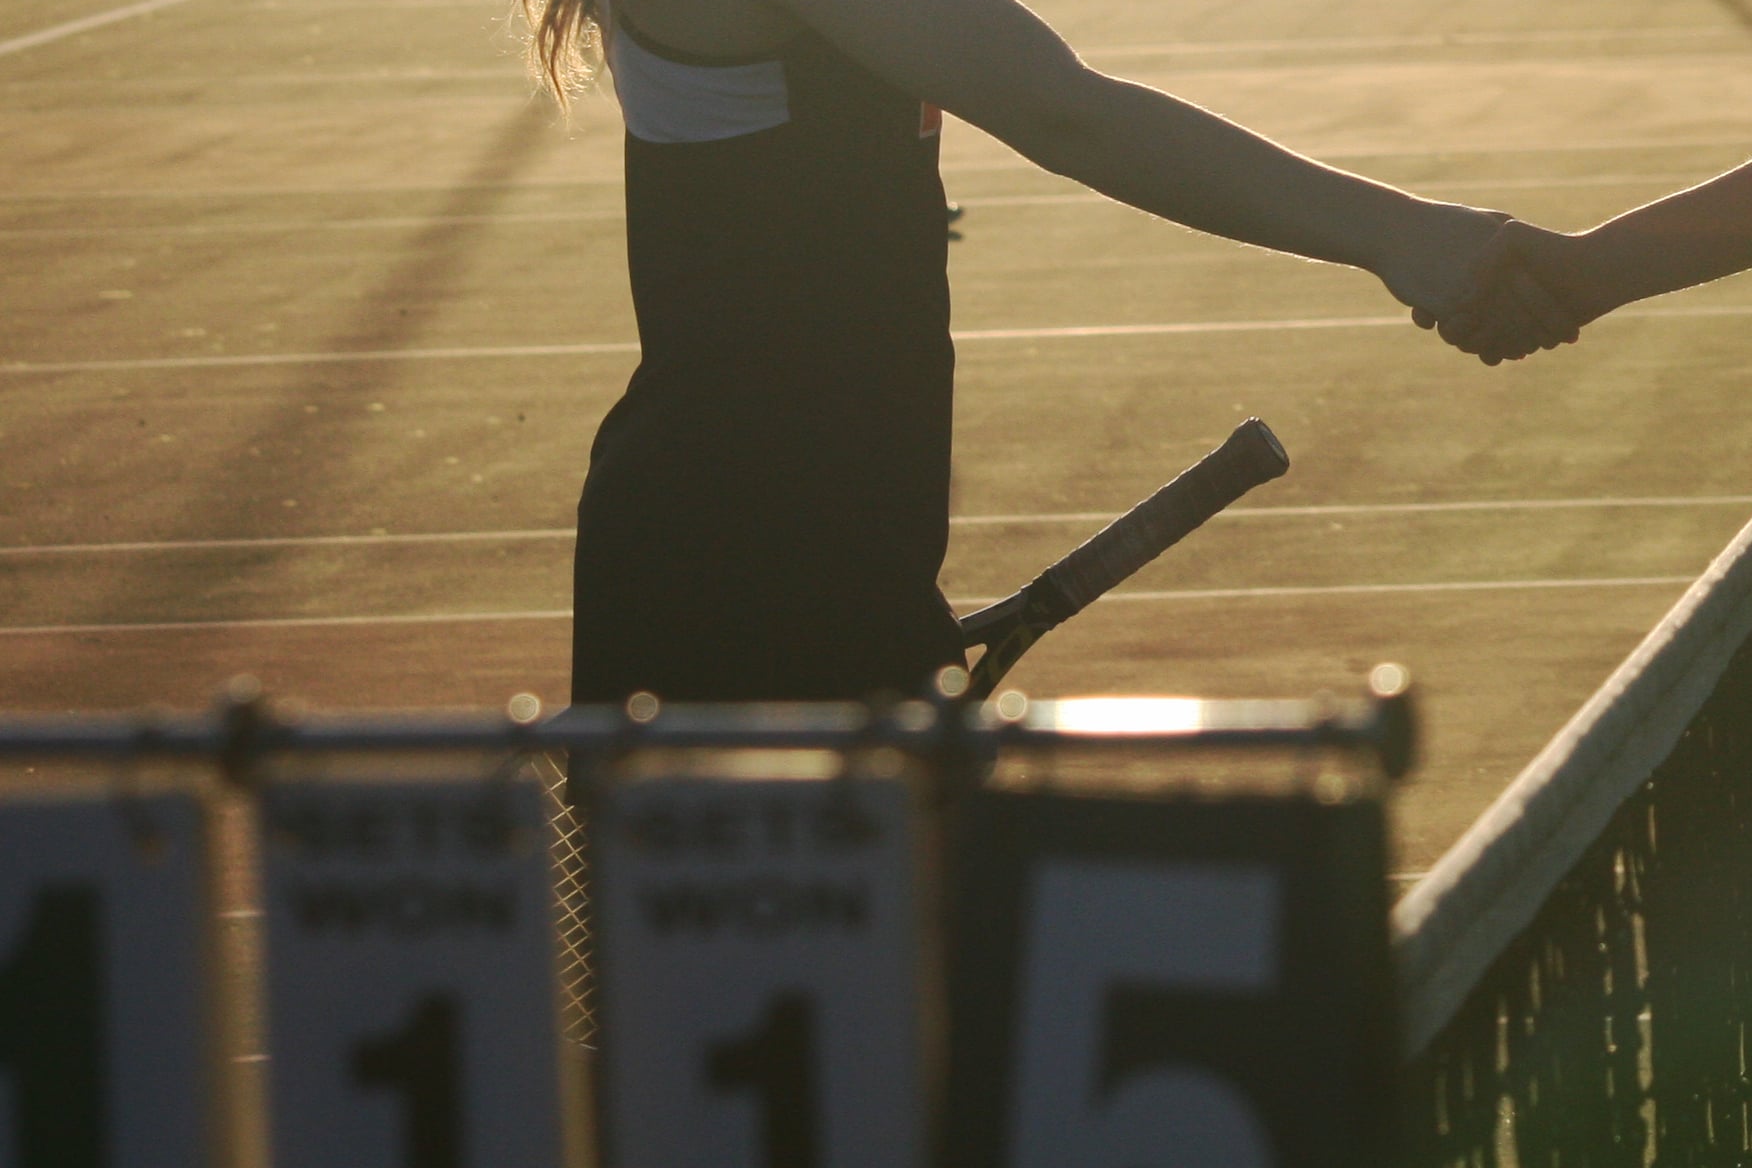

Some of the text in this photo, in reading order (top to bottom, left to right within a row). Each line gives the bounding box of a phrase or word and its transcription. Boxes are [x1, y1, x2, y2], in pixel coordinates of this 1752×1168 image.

[287, 879, 518, 936] WON
[640, 877, 872, 936] WON
[343, 983, 470, 1168] 1
[698, 984, 821, 1168] 1
[1016, 862, 1286, 1168] 5
